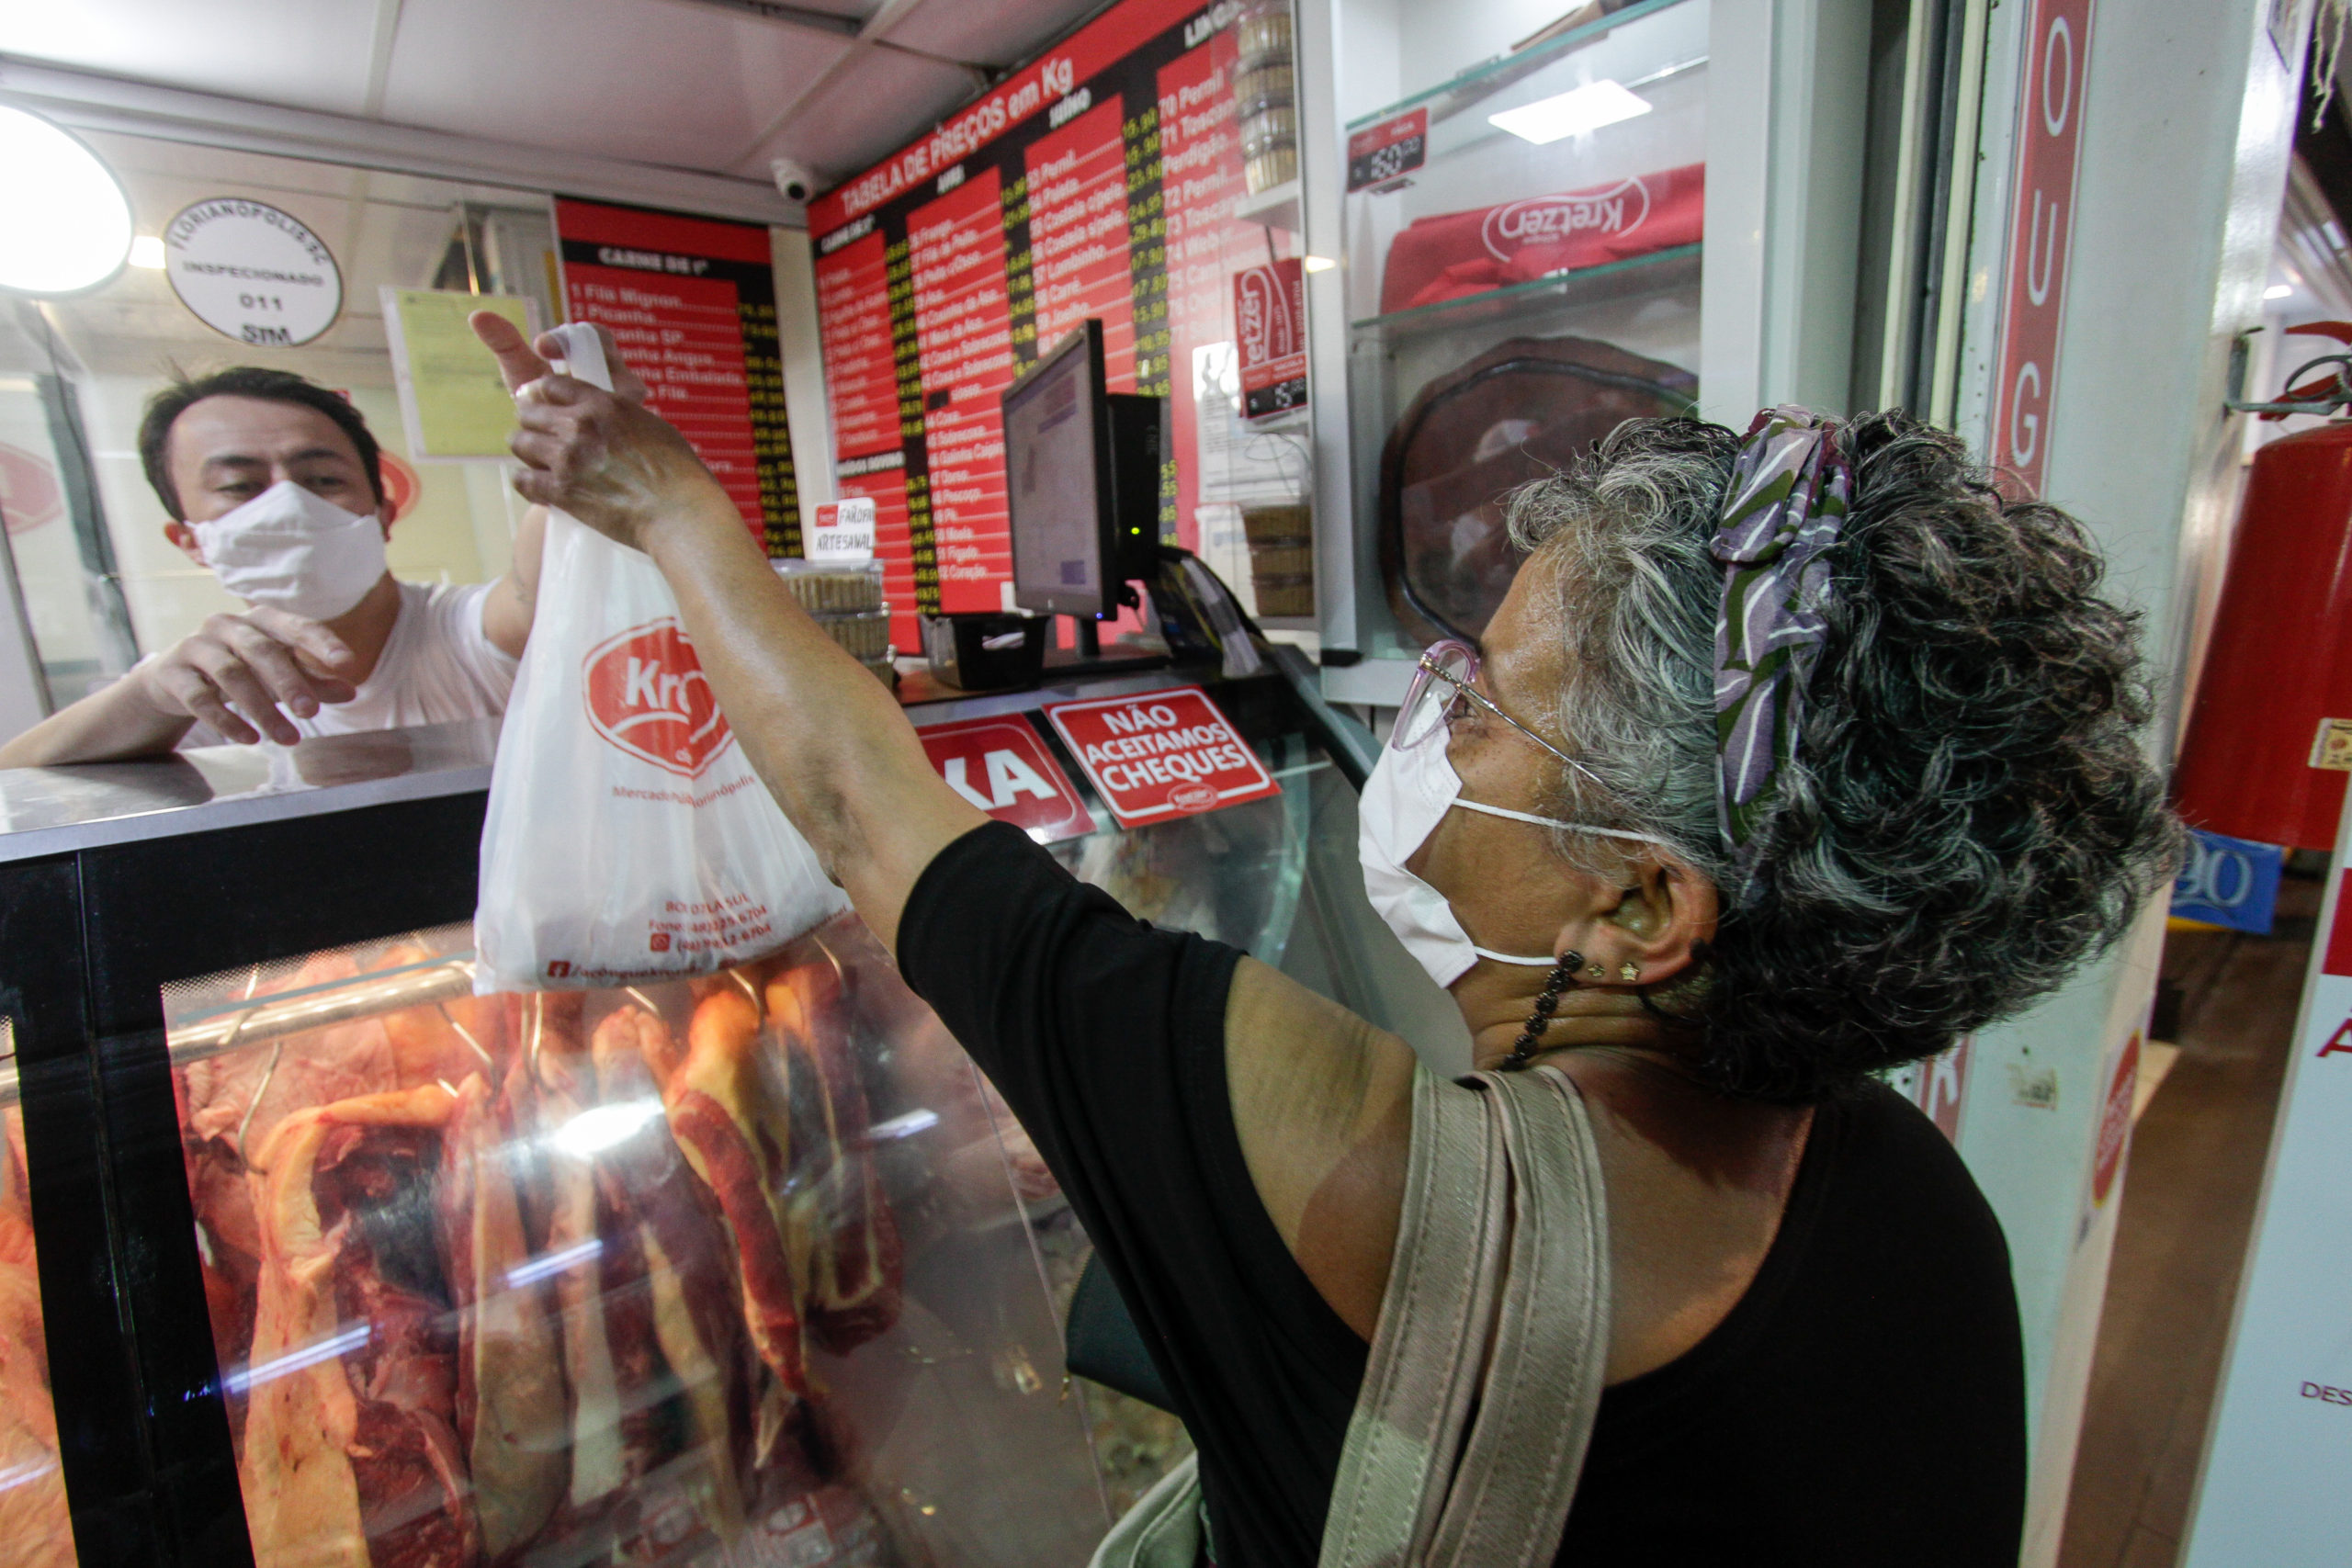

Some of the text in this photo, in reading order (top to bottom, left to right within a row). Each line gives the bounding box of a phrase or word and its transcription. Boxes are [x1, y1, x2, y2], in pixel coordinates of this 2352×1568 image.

[842, 58, 1074, 216] TABELA DE PREÇOS em Kg
[1041, 148, 1076, 184] Pernil
[1516, 197, 1624, 238] Kretzer
[1047, 243, 1107, 281] Lombinho
[240, 293, 283, 310] 011
[949, 562, 988, 581] Coração
[1102, 704, 1179, 736] NÃO
[1086, 722, 1229, 766] ACEITAMOS
[1102, 744, 1248, 793] CHEQUES
